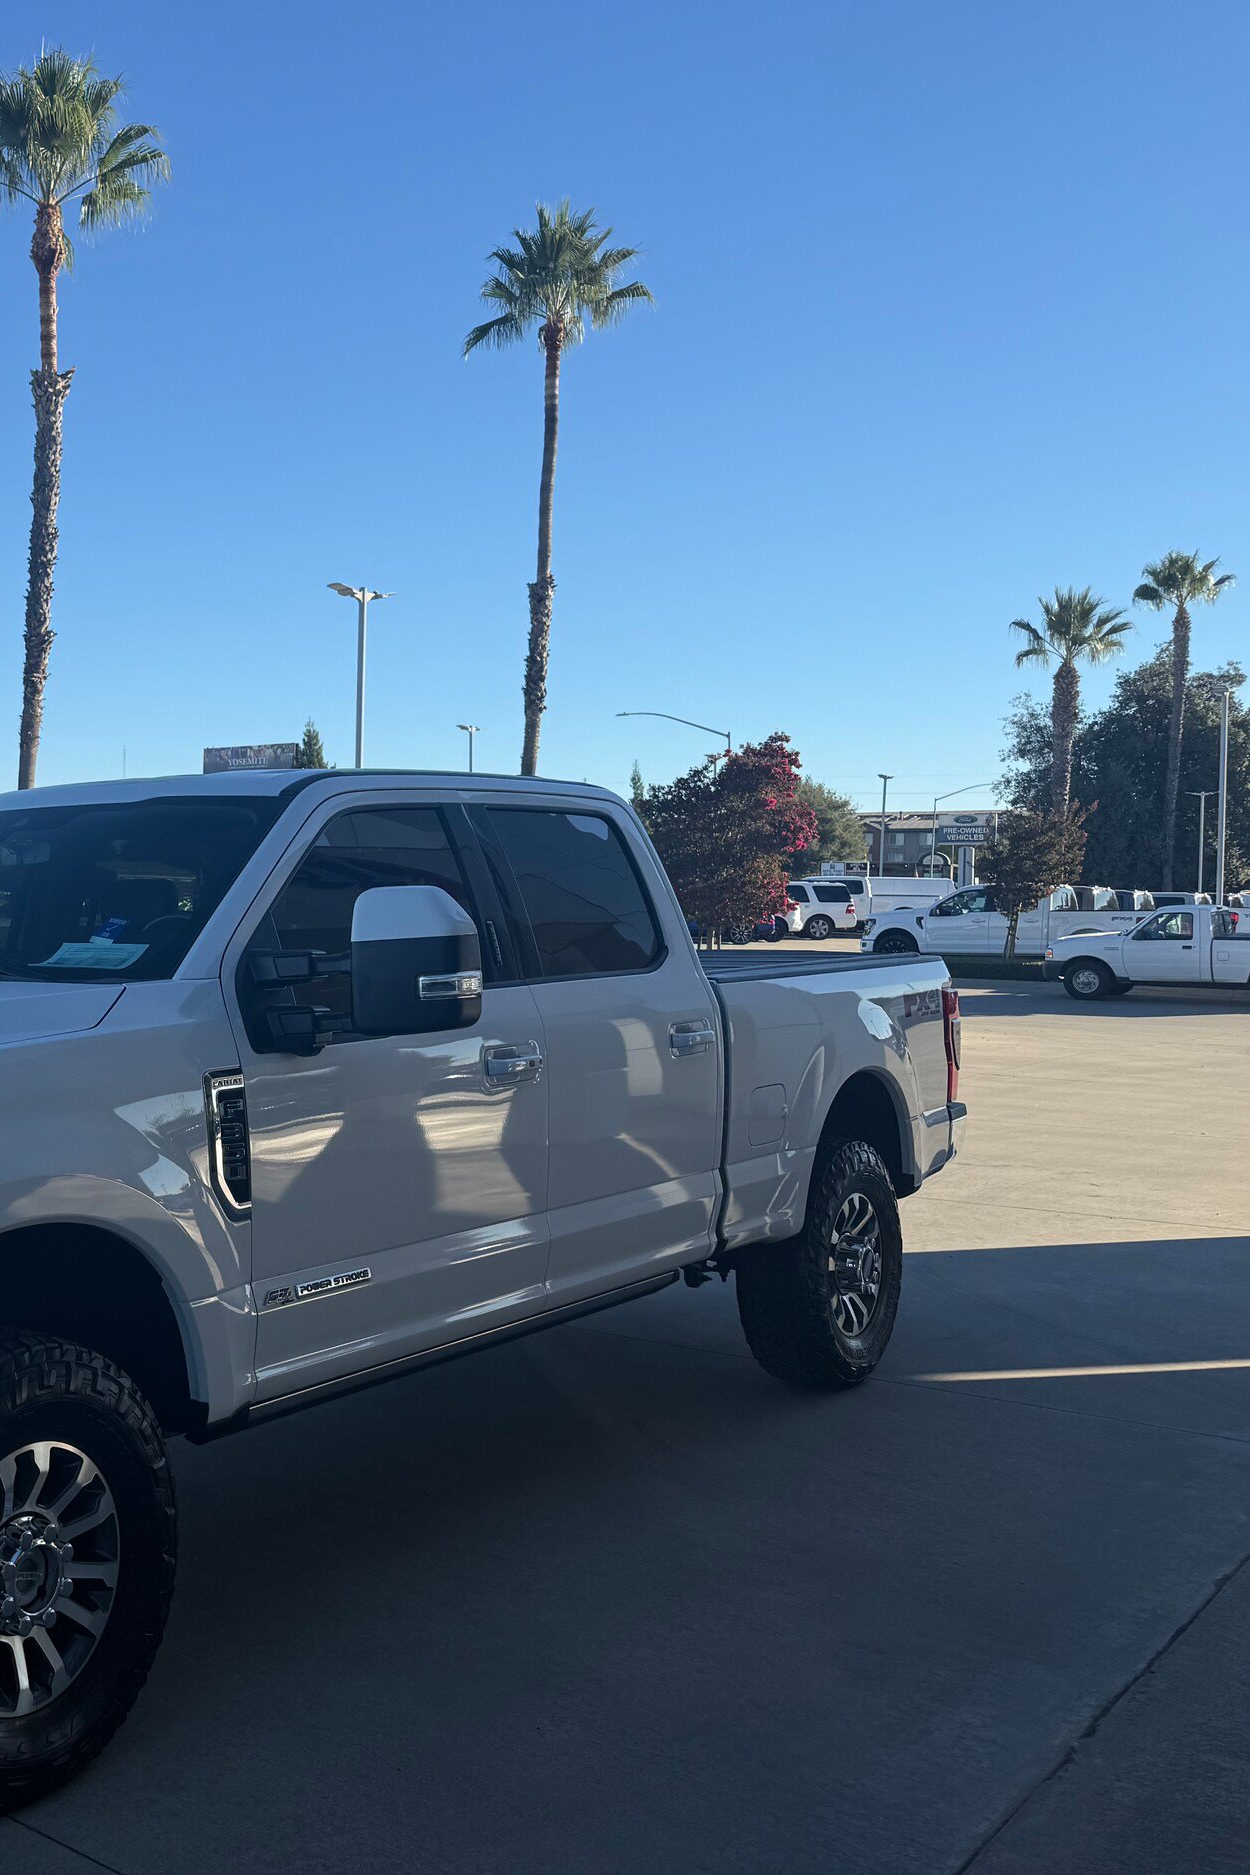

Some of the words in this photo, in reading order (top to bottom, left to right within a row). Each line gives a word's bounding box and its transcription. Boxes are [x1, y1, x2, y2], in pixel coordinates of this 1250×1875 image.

[228, 757, 269, 766] YOSEMITE
[903, 989, 941, 1017] FX4
[212, 1077, 243, 1087] LARIAT
[299, 1279, 332, 1295] POWER
[333, 1269, 370, 1286] STROKE
